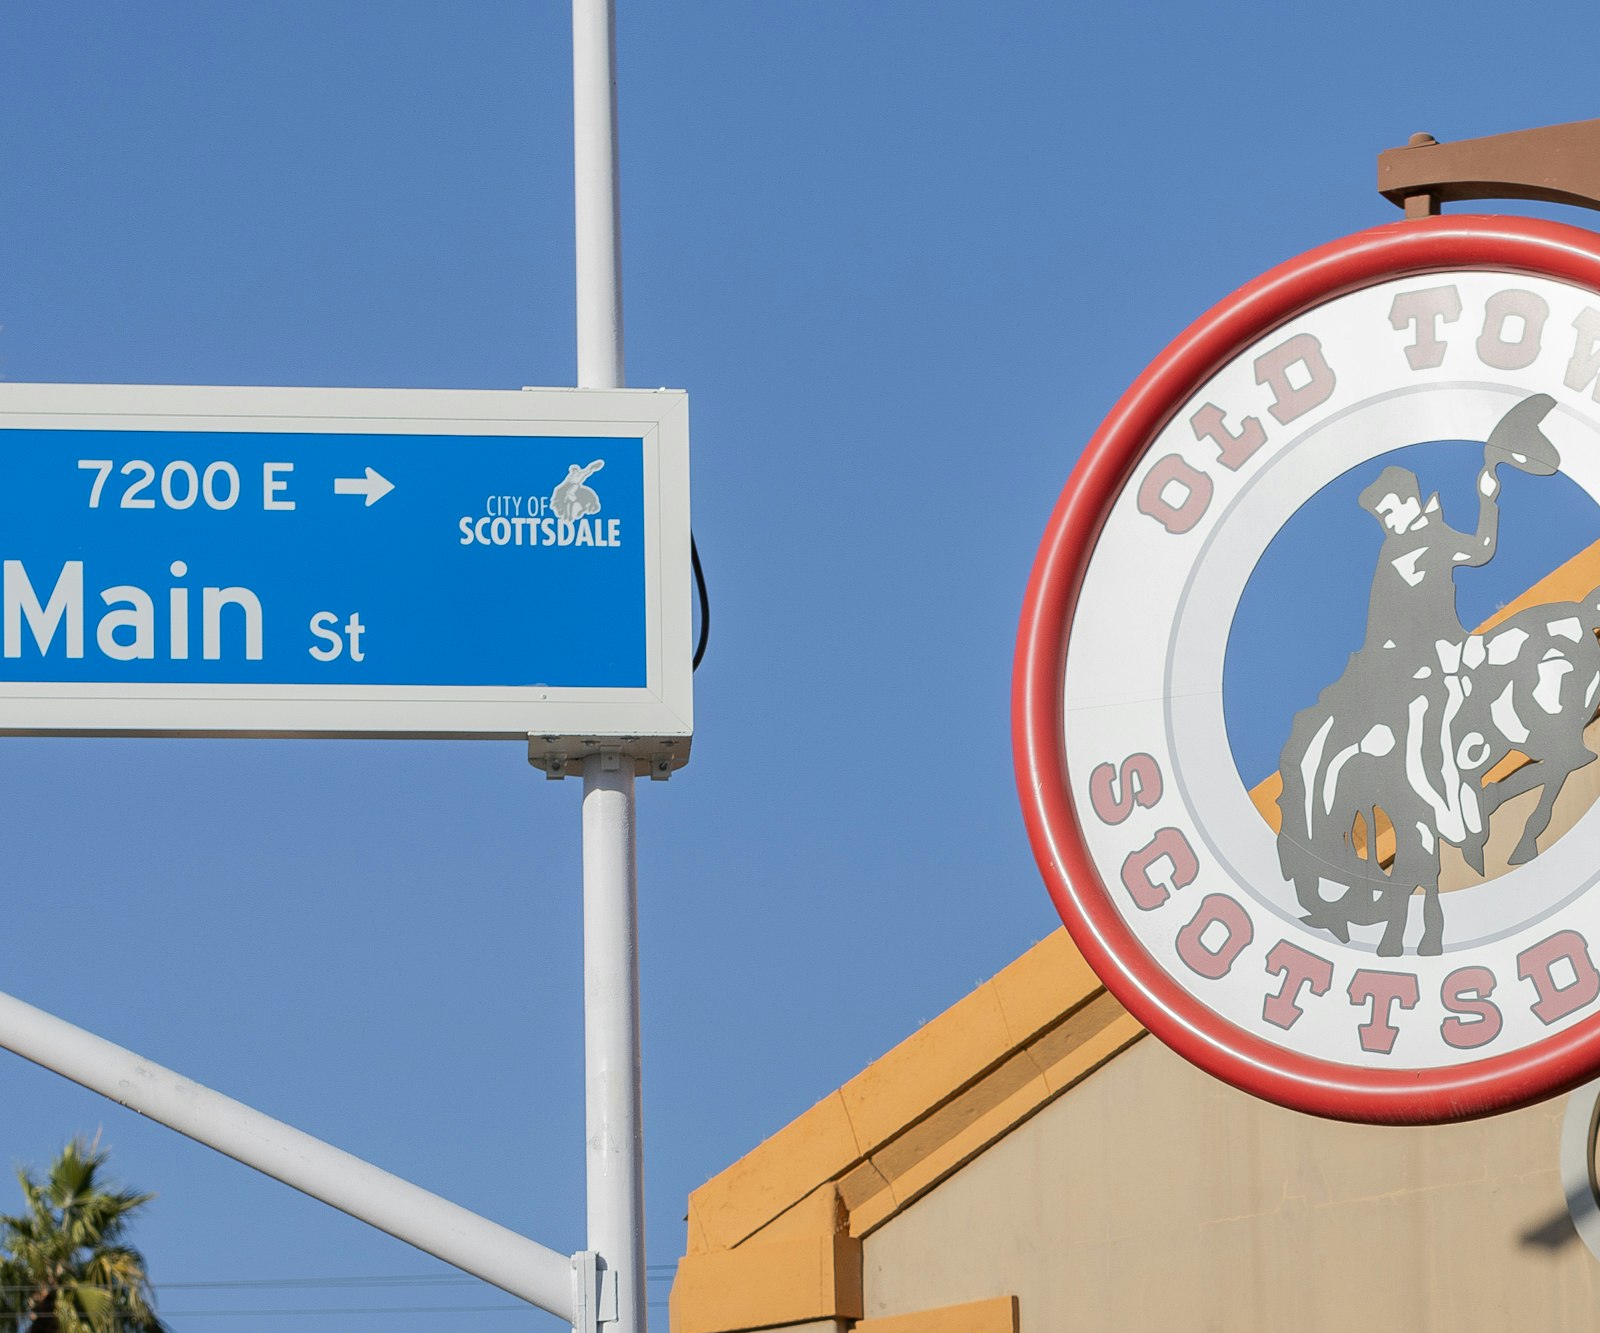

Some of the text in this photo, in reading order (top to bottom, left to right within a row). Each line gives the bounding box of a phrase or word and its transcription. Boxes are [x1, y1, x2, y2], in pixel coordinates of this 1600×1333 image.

[1137, 333, 1337, 535] OLD
[77, 459, 296, 511] 7200 E
[486, 496, 549, 517] CITY OF
[458, 517, 622, 547] SCOTTSDALE
[3, 560, 366, 663] Main St
